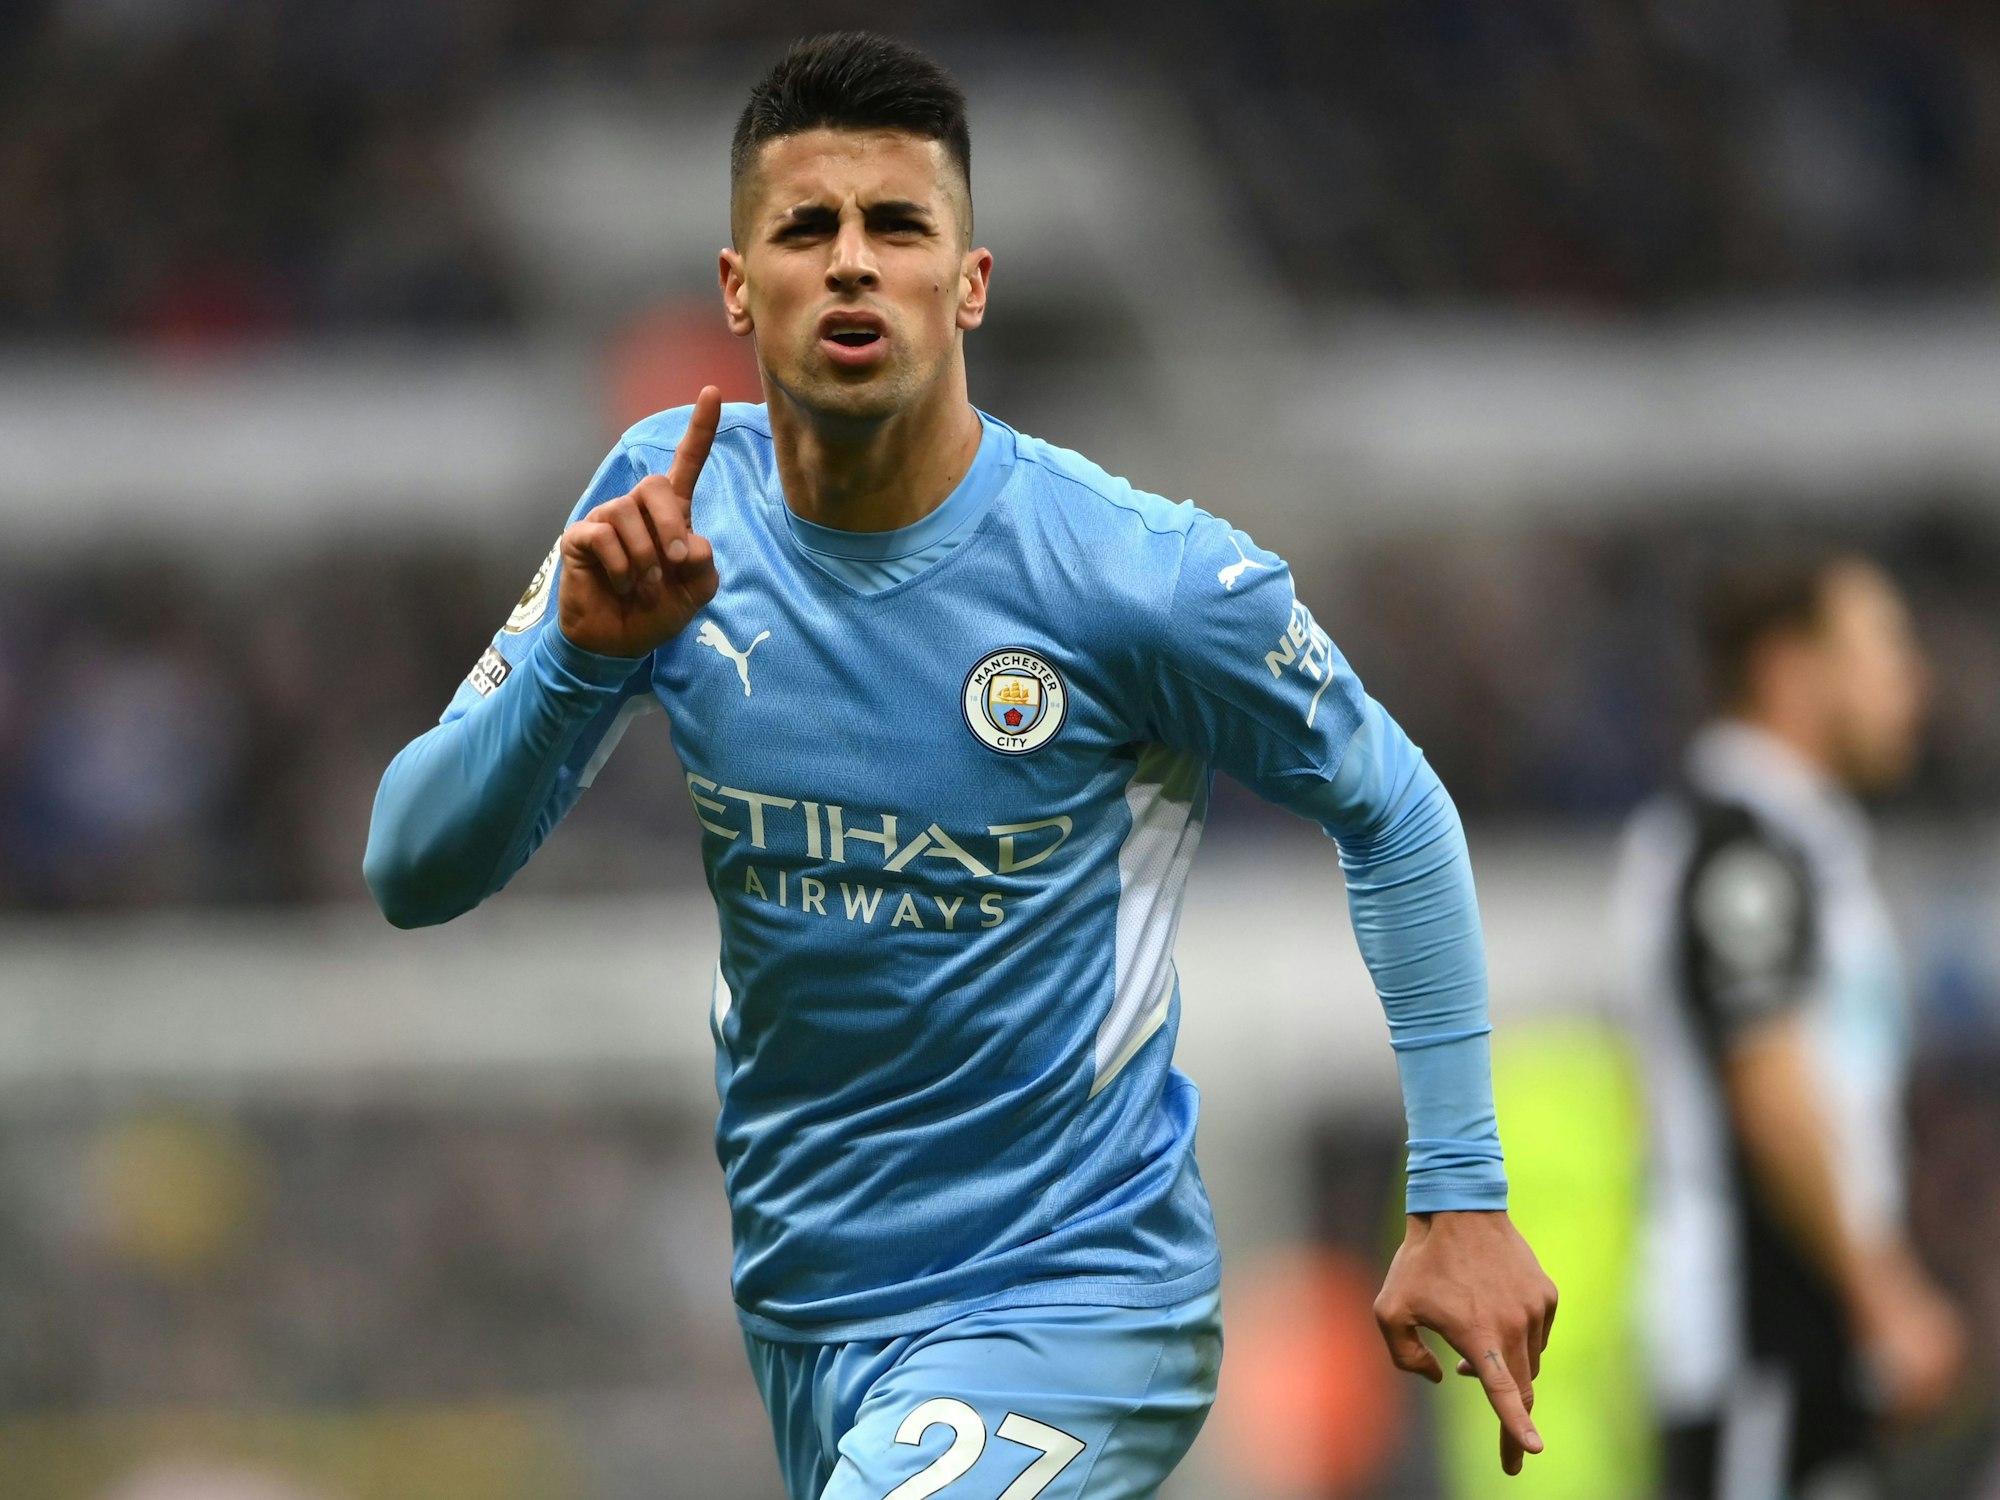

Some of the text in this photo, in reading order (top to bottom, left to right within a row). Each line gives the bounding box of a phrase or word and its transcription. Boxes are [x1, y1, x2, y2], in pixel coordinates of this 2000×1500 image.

[974, 656, 1057, 692] MANCHESTER
[996, 736, 1027, 748] CITY
[686, 771, 1073, 878] ETIHAD
[744, 864, 1005, 930] AIRWAYS
[881, 1396, 1087, 1500] 27
